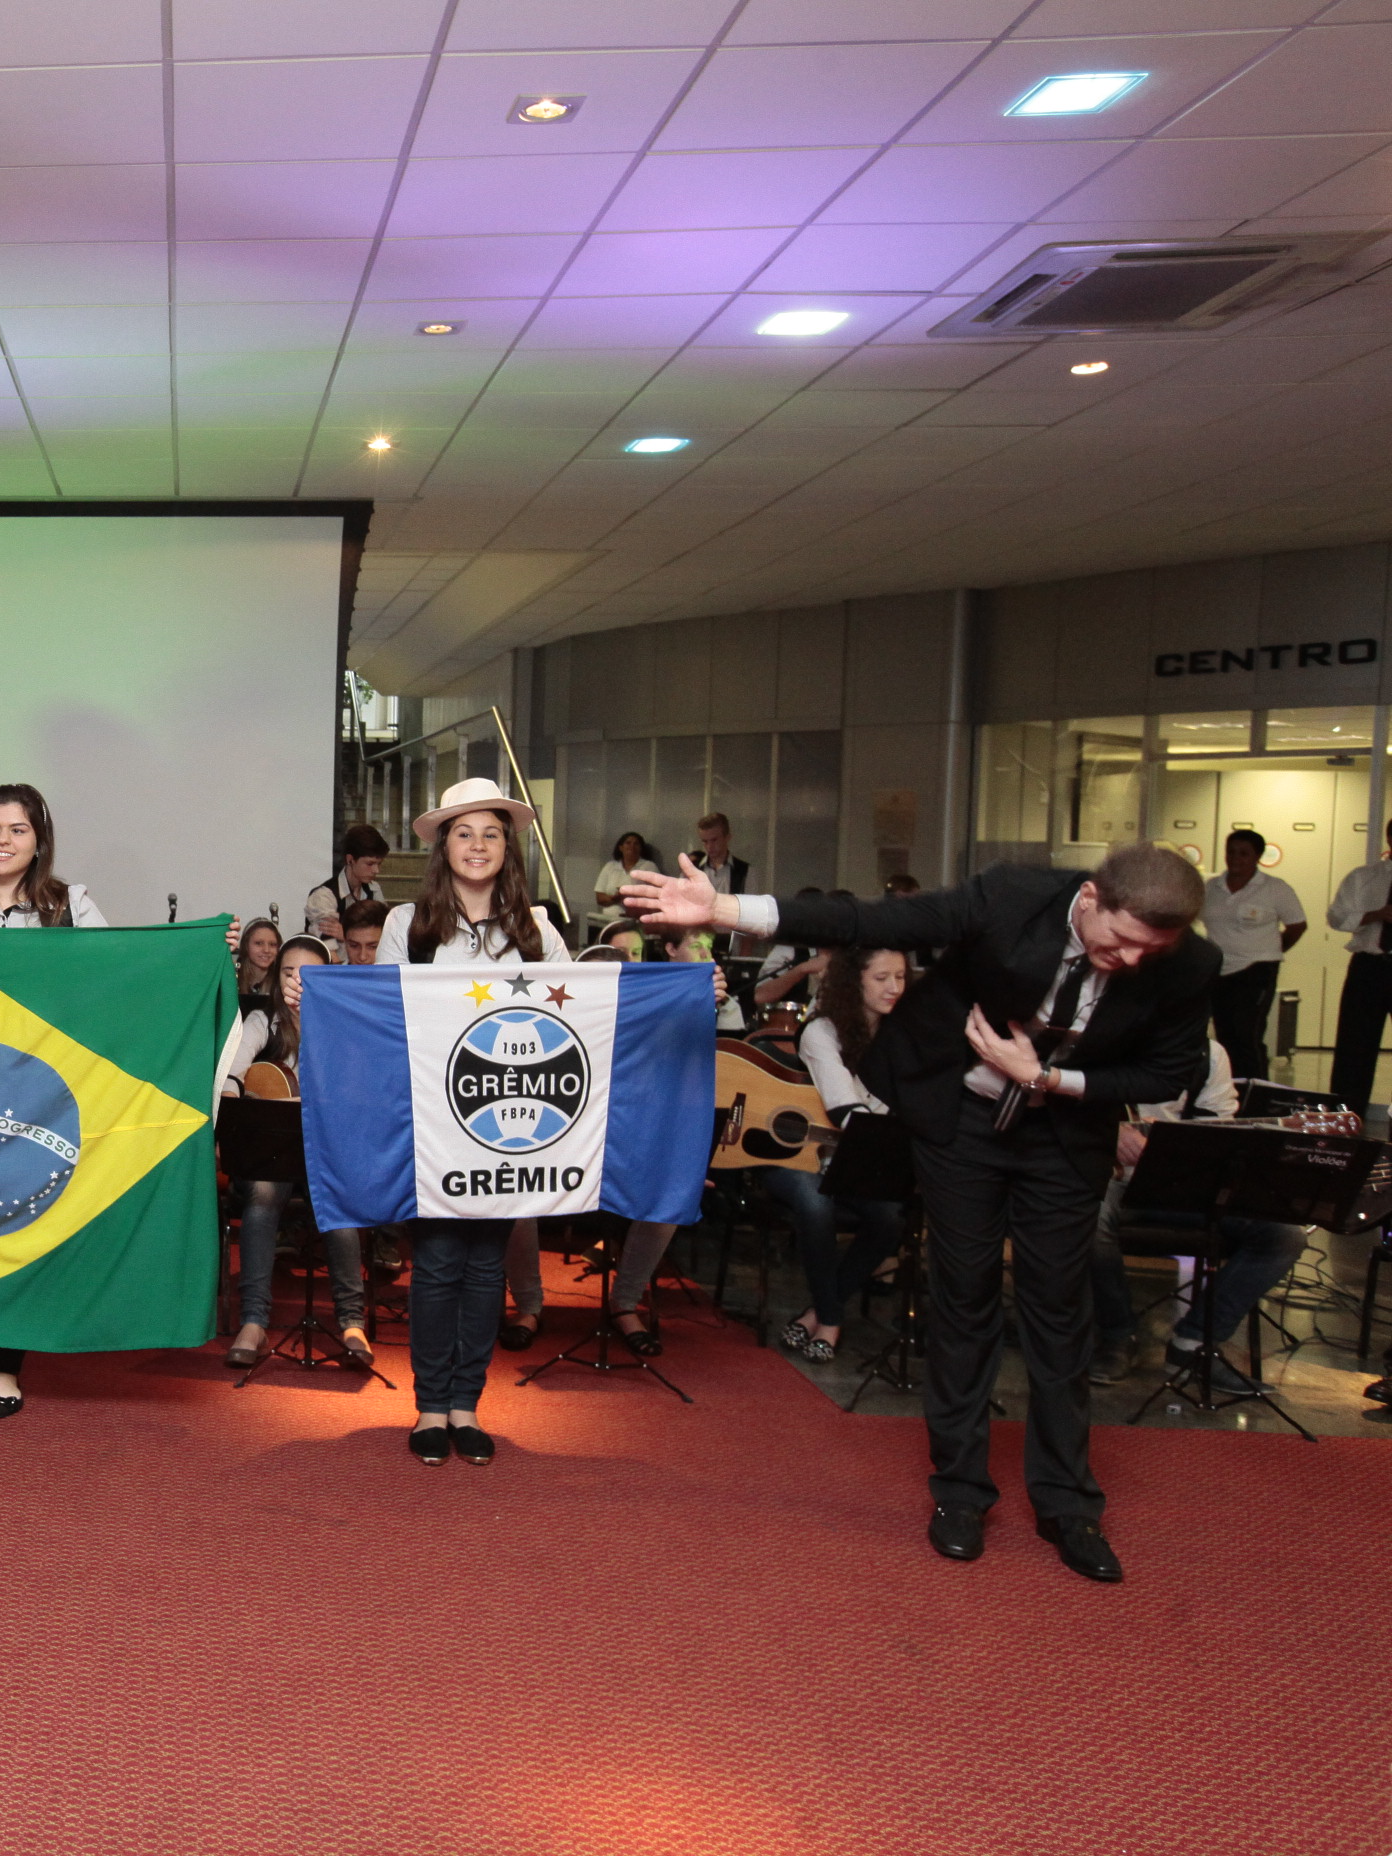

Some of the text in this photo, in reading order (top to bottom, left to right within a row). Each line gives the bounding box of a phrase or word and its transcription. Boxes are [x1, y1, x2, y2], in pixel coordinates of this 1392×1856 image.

[1155, 638, 1377, 677] CENTRO
[503, 1041, 536, 1056] 1903
[458, 1066, 581, 1098] GRÊMIO
[501, 1107, 536, 1121] FBPA
[1307, 1153, 1348, 1168] Violões
[441, 1161, 585, 1197] GRÊMIO
